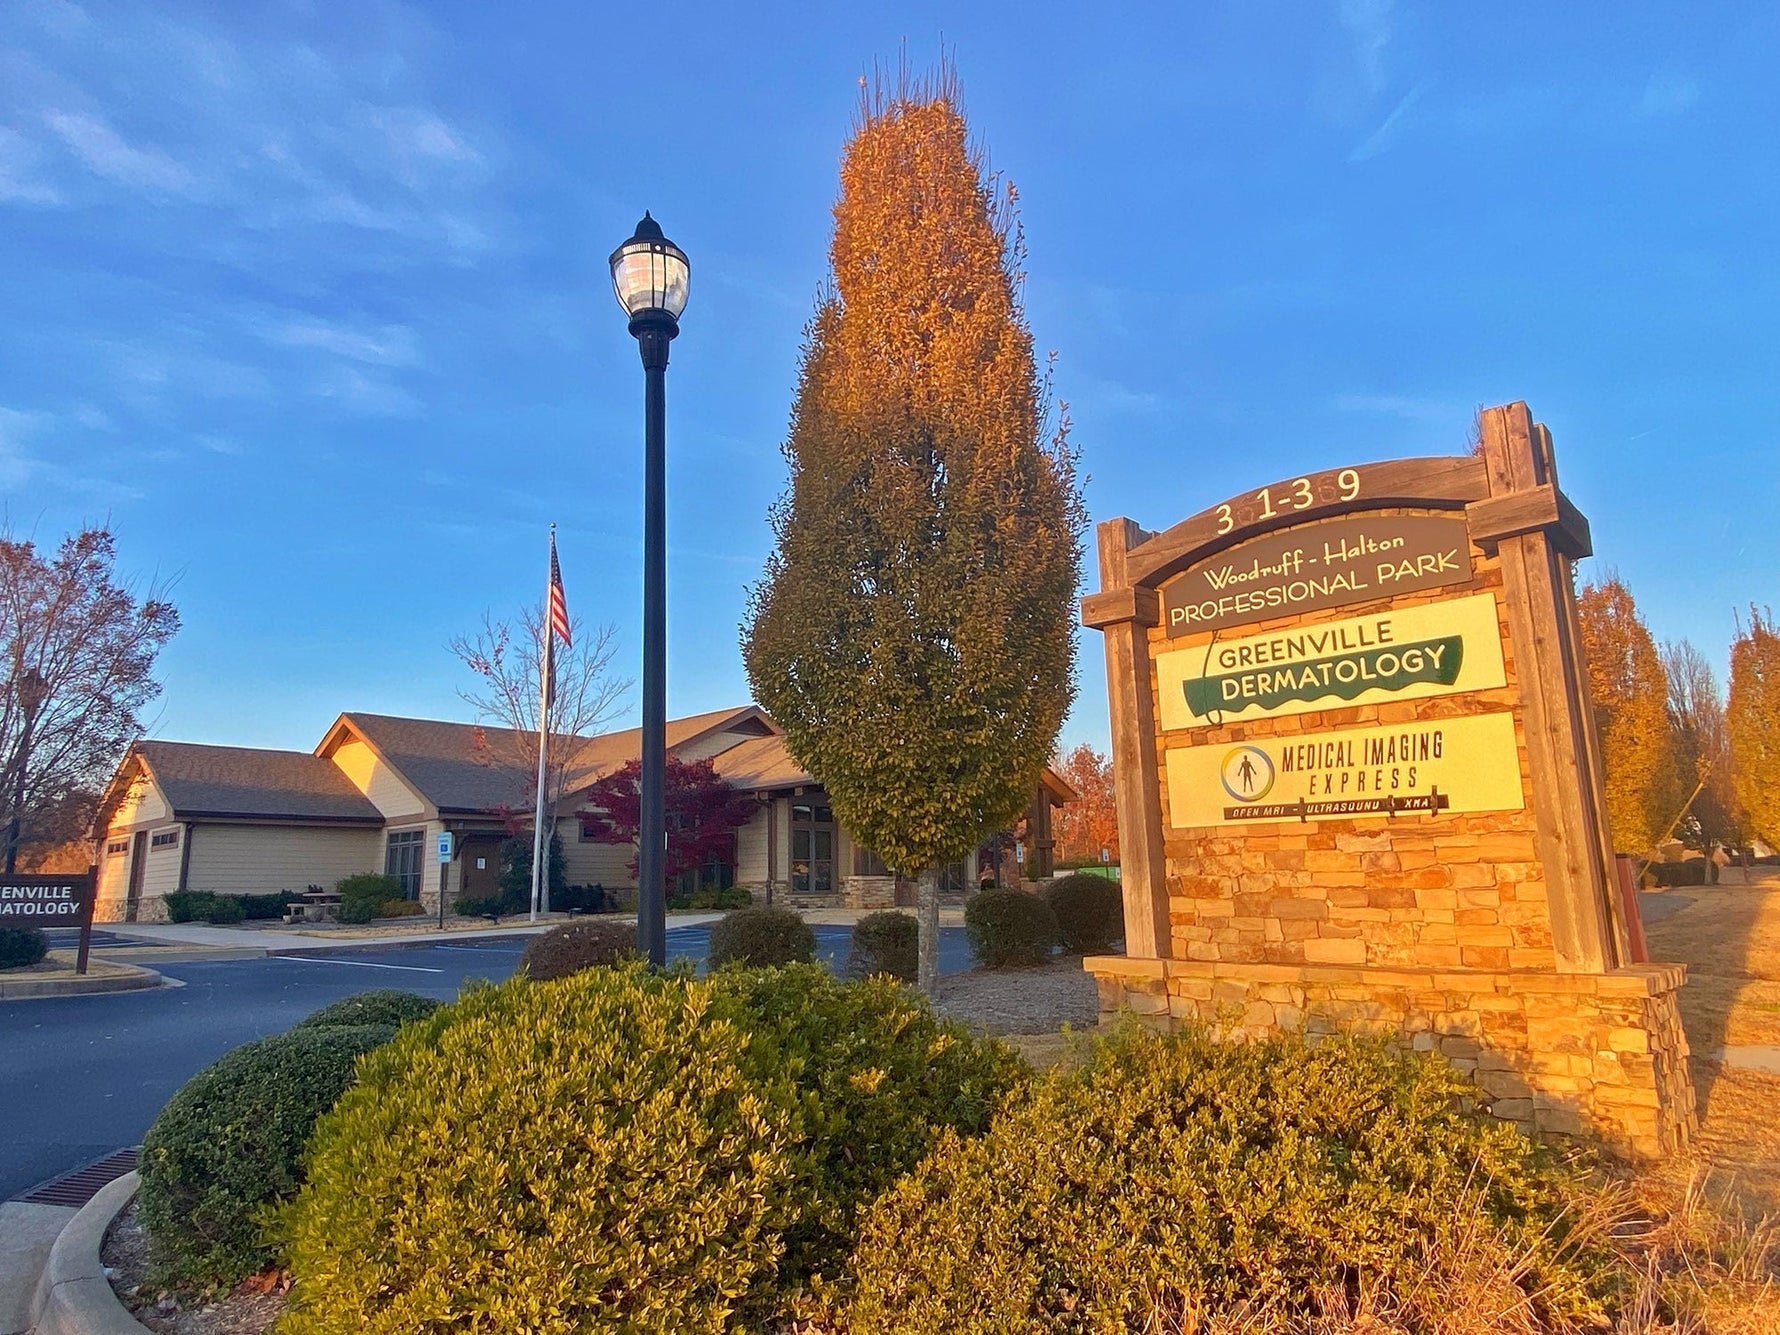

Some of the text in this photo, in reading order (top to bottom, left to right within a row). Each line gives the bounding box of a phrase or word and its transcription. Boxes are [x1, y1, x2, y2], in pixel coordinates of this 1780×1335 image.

[1203, 549, 1303, 590] Woodruff
[1324, 534, 1405, 565] Halton
[1171, 549, 1460, 626] PROFESSIONAL PARK
[1219, 620, 1393, 669] GREENVILLE
[1221, 644, 1446, 701] DERMATOLOGY
[1282, 730, 1443, 772] MEDICAL IMAGING
[1309, 766, 1417, 795] EXPRESS
[1232, 807, 1259, 817] OPEN
[1263, 806, 1285, 816] MRI
[1306, 800, 1380, 813] ULTRASOUND
[0, 886, 72, 899] ENVILLE
